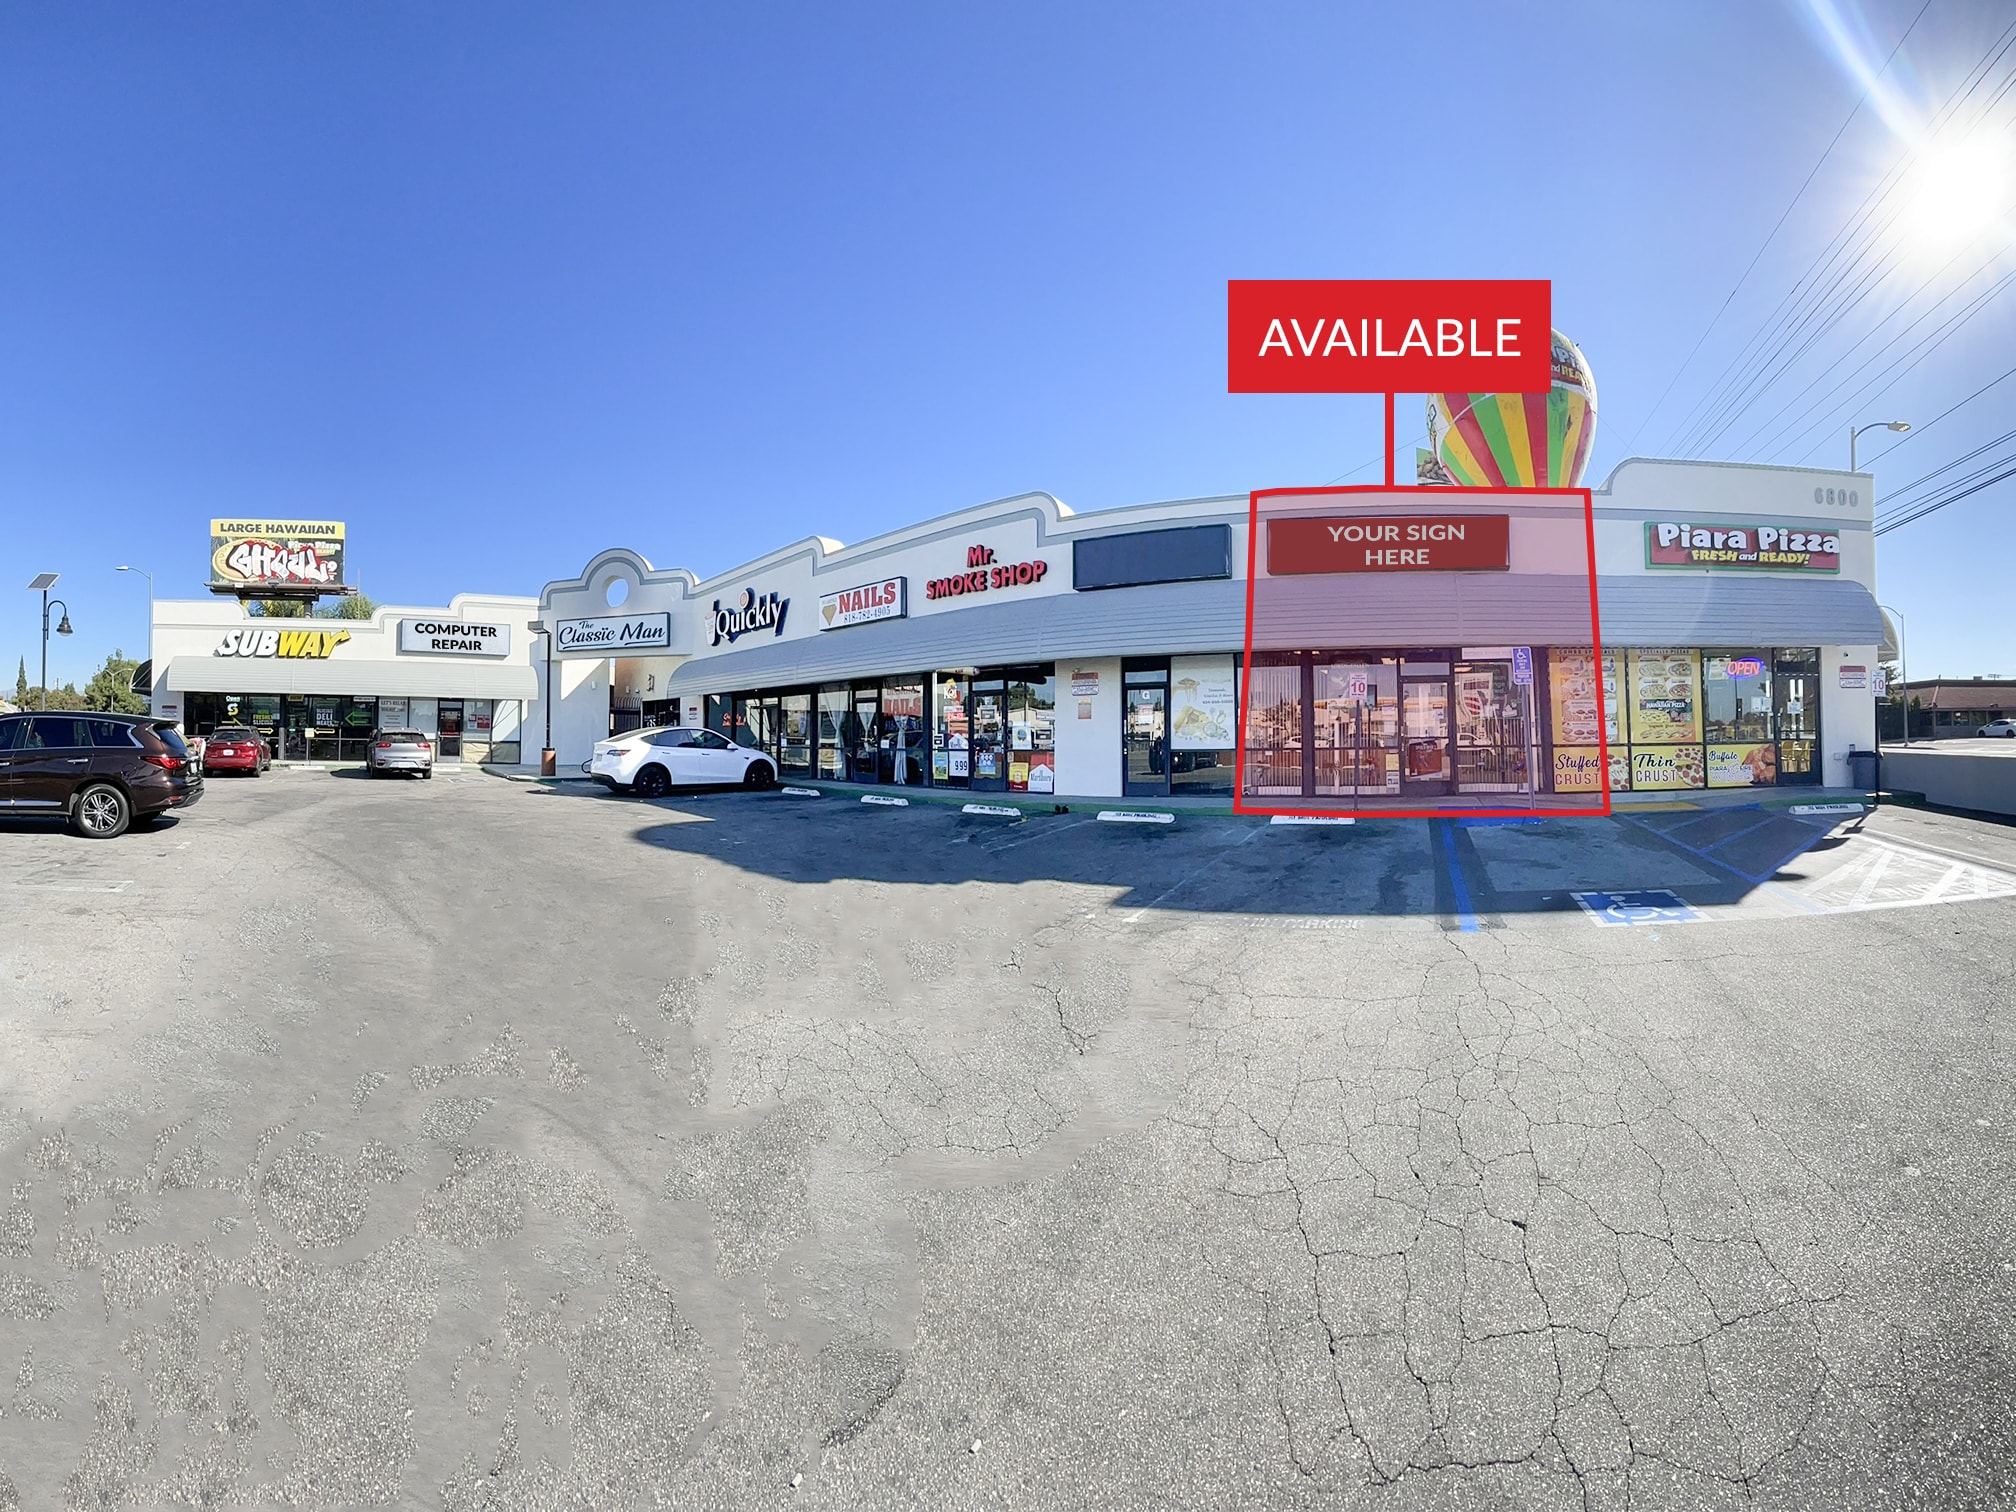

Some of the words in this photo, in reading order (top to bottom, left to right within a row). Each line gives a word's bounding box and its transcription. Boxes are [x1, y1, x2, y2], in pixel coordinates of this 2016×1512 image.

[1814, 487, 1859, 507] 6800
[220, 523, 262, 533] LARGE
[265, 524, 336, 534] HAWAIIAN
[1657, 523, 1748, 549] Piara
[1757, 526, 1840, 554] Pizza
[966, 544, 998, 568] Mr.
[1691, 550, 1739, 562] FRESH
[1738, 552, 1757, 561] and
[1758, 551, 1811, 565] READY!
[926, 570, 988, 600] SMOKE
[990, 560, 1048, 589] SHOP
[838, 582, 896, 614] NAILS
[715, 590, 784, 641] Quickly
[843, 605, 891, 624] 818-782-4905
[414, 622, 498, 638] COMPUTER
[579, 620, 595, 630] The
[619, 621, 666, 641] Man
[216, 629, 351, 658] SUBWAY
[431, 638, 482, 651] REPAIR
[1727, 661, 1760, 676] OPEN
[1350, 682, 1366, 693] 10
[1871, 680, 1885, 690] 10
[1142, 691, 1150, 700] G
[1555, 753, 1600, 773] Stuffed
[1633, 753, 1676, 768] Thin
[1708, 750, 1738, 763] Buffalo
[1555, 773, 1600, 785] CRUST
[1636, 769, 1677, 782] CRUST
